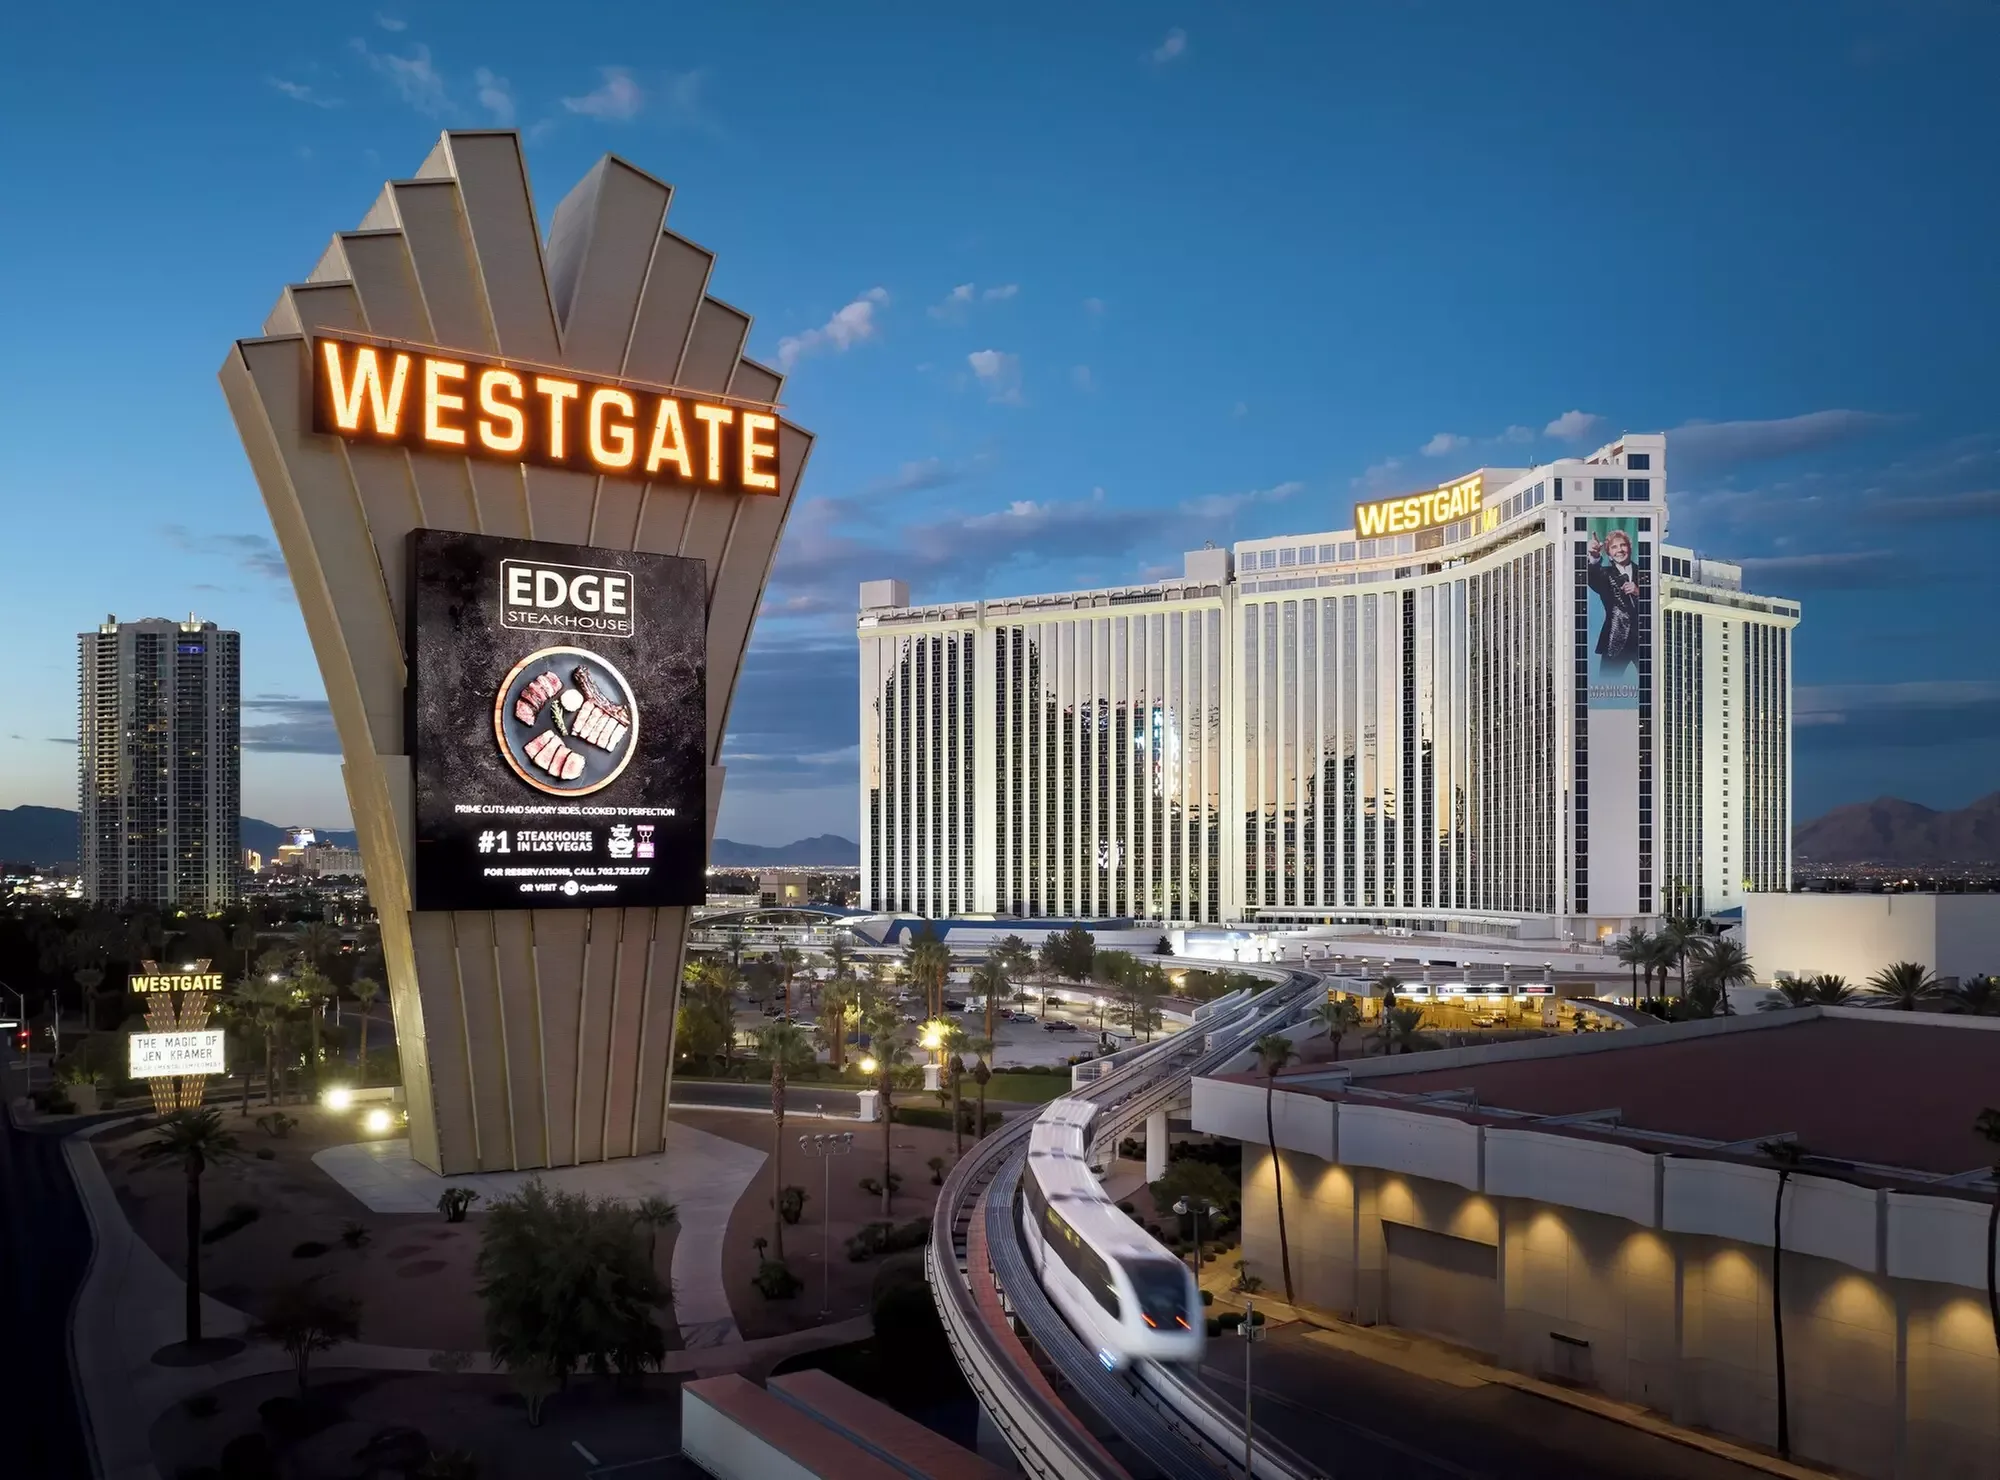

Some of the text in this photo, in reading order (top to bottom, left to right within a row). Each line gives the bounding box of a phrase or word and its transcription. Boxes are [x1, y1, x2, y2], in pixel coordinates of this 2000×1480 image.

[323, 342, 776, 489] WESTGATE
[1357, 476, 1481, 536] WESTGATE
[508, 567, 627, 615] EDGE
[507, 610, 628, 631] STEAKHOUSE
[1589, 684, 1638, 699] MANILOW
[454, 804, 675, 817] PRIME CUTS AND SAVORY SIDES, COOKED TO PERFECTION
[478, 830, 511, 854] #1
[516, 831, 592, 842] STEAKHOUSE
[517, 841, 593, 852] IN LAS VEGAS
[484, 867, 503, 877] FOR
[573, 867, 597, 877] CALL
[520, 883, 534, 892] OR
[534, 883, 558, 892] VISIT
[131, 975, 223, 993] WESTGATE
[137, 1035, 218, 1049] THE MAGIC OF
[142, 1048, 213, 1062] JEN KRAMER
